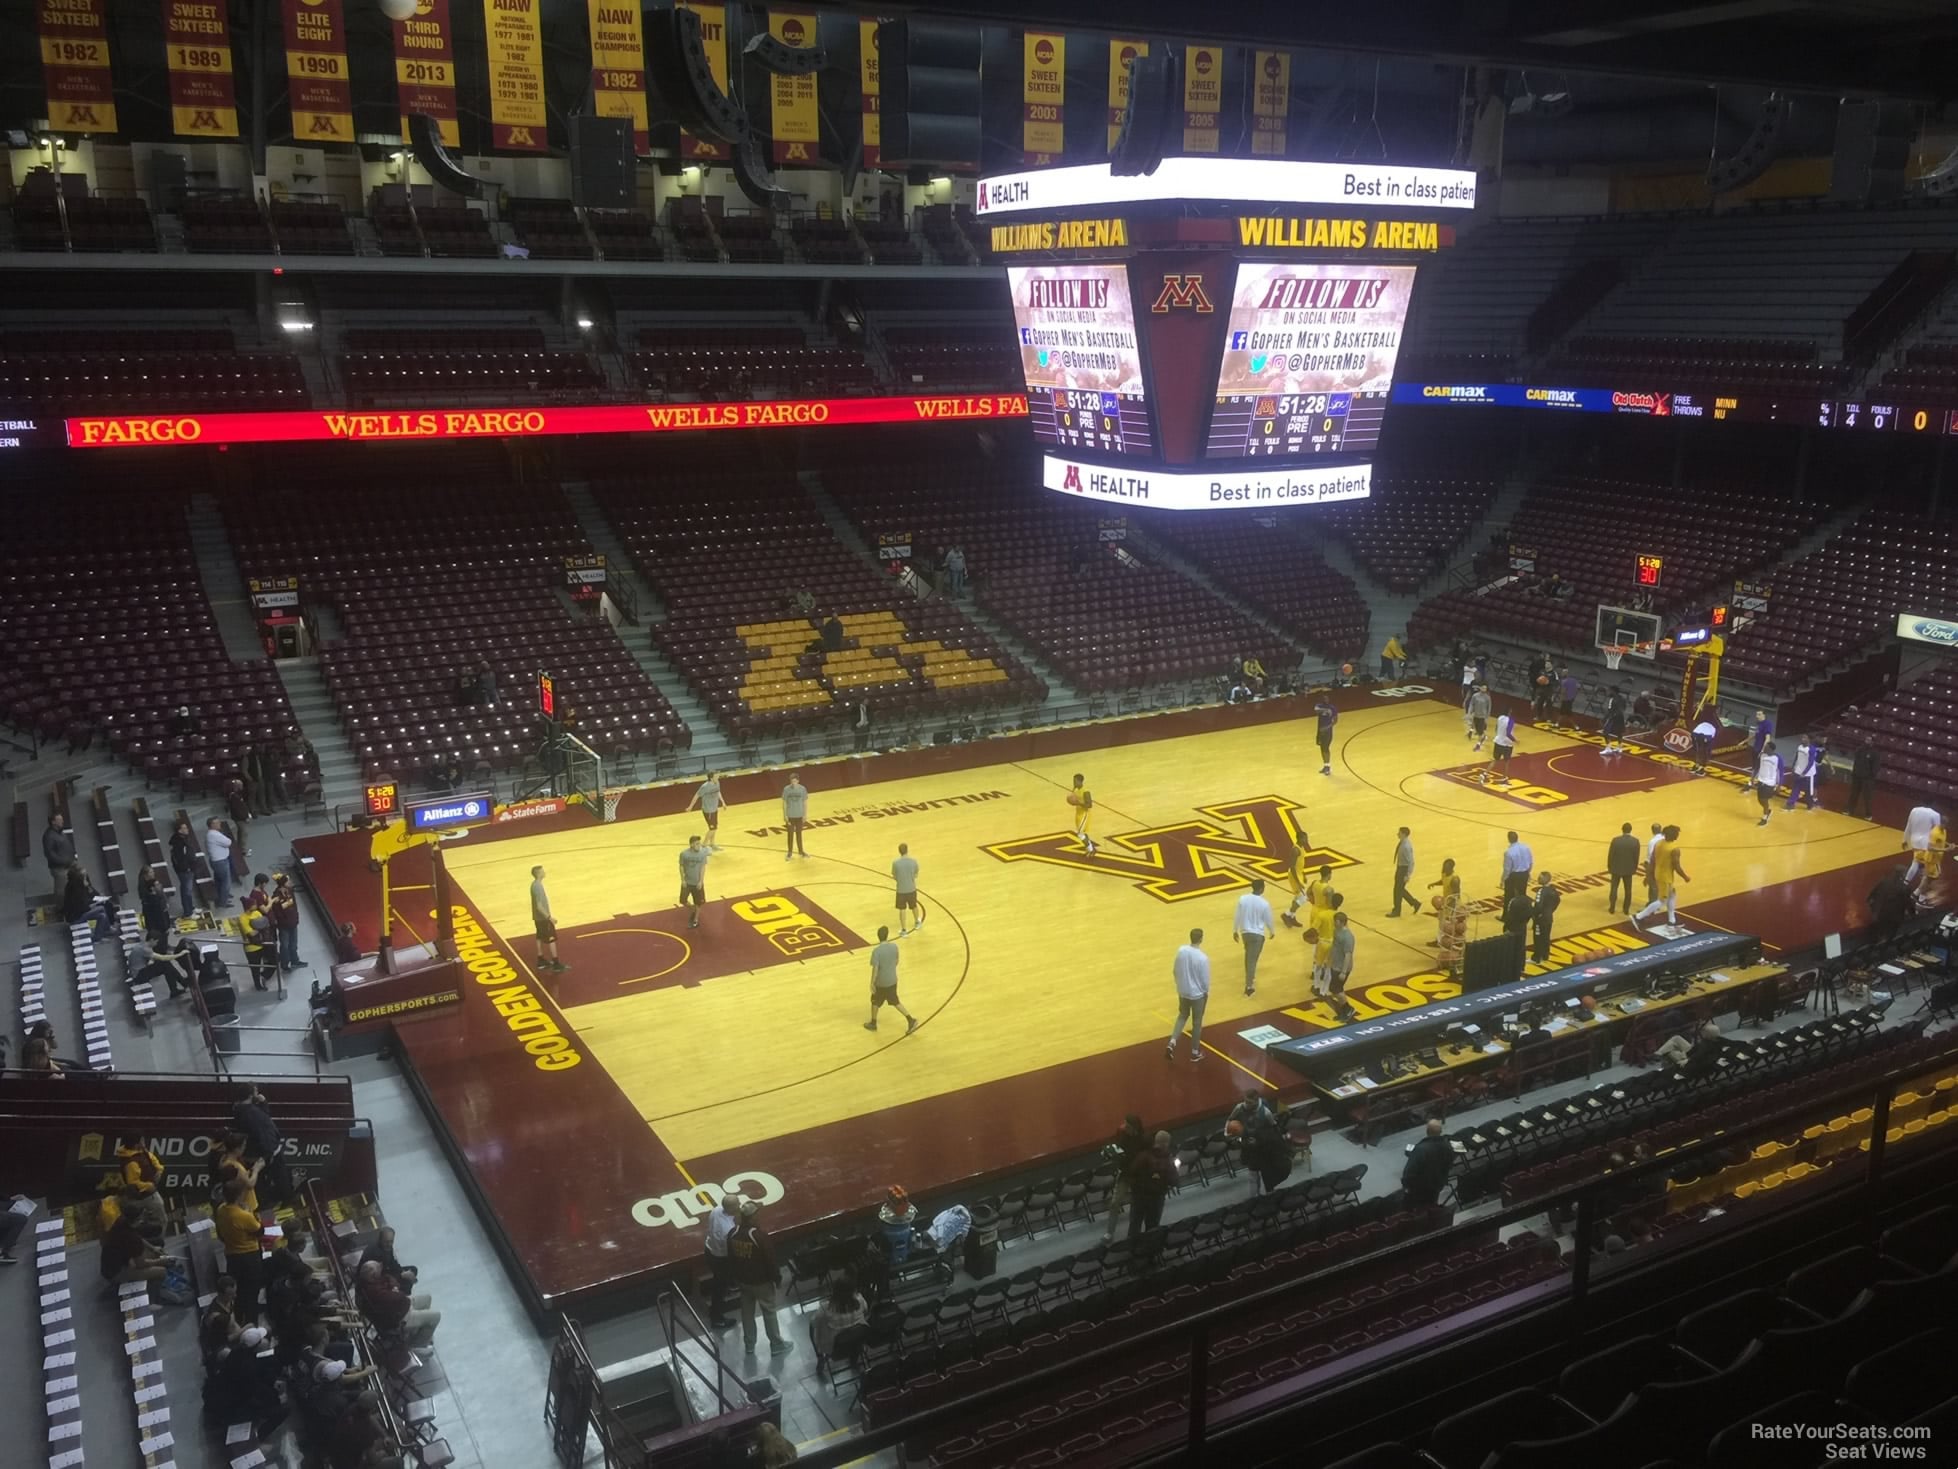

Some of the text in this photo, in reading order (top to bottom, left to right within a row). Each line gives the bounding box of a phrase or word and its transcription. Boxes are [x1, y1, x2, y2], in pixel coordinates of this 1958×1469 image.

[43, 11, 99, 26] SIXTEEN
[172, 4, 217, 19] SWEET
[296, 12, 330, 27] ELITE
[597, 9, 633, 25] AIAW
[169, 18, 223, 35] SIXTEEN
[296, 27, 332, 42] EIGHT
[405, 20, 440, 35] THIRD
[495, 30, 512, 39] 1977
[403, 35, 444, 50] ROUND
[597, 32, 636, 42] REGION VI
[51, 43, 99, 62] 1982
[594, 41, 641, 52] CHAMPIONS
[177, 49, 222, 68] 1989
[506, 52, 525, 61] 1982
[296, 56, 339, 75] 1990
[406, 64, 445, 81] 2013
[601, 71, 637, 89] 1982
[1031, 71, 1057, 81] SWEET
[1028, 82, 1060, 94] SIXTEEN
[1191, 80, 1216, 91] SWEET
[1188, 92, 1218, 102] SIXTEEN
[1030, 106, 1057, 119] 2003
[1190, 114, 1214, 127] 2005
[992, 181, 1029, 205] HEALTH
[1344, 174, 1381, 196] Best
[1387, 176, 1400, 196] in
[1405, 176, 1437, 198] class
[992, 218, 1127, 251] WILLIAMS ARENA
[1239, 217, 1438, 250] WILLIAMS ARENA
[1032, 279, 1106, 308] FOLLOW US
[1267, 279, 1382, 308] FOLLOW US
[1056, 311, 1076, 323] SOCIAL
[1077, 311, 1097, 323] MEDIA
[1283, 311, 1356, 324] ON SOCIAL MEDIA
[1086, 330, 1134, 349] BASKETBALL
[1251, 330, 1396, 350] GOPHER MEN'S BASKETBALL
[914, 397, 1029, 418] WELLS FA
[1068, 391, 1101, 412] 51:28
[1279, 395, 1326, 415] 51:28
[1629, 393, 1654, 408] Dutch
[1674, 395, 1691, 405] FREE
[1715, 398, 1737, 409] MINN
[647, 403, 829, 428] WELLS FARGO
[1674, 406, 1702, 416] THROWS
[1714, 409, 1726, 420] NU
[1871, 405, 1893, 415] FOULS
[324, 411, 546, 437] WELLS FARGO
[1064, 413, 1111, 430] 0 PRE 0
[1264, 418, 1332, 434] 0 PRE 0
[1846, 414, 1884, 429] 4 0
[1914, 410, 1927, 431] 0
[80, 418, 202, 443] FARGO
[1249, 447, 1256, 456] 4
[1267, 446, 1273, 455] 0
[1331, 442, 1338, 451] 4
[1090, 473, 1366, 501] HEALTH Best in class patient
[1639, 556, 1661, 569] 51:28
[1640, 566, 1657, 583] 30
[1921, 623, 1956, 641] Ford
[1669, 732, 1691, 750] DQ
[368, 785, 394, 799] 51:28
[374, 798, 391, 810] 30
[861, 789, 1012, 820] WILLIAMS
[423, 806, 464, 822] Allianz
[1280, 929, 1650, 1030] MINNSOTA
[1513, 979, 1559, 995] FROM
[1476, 991, 1509, 1004] NYC
[349, 991, 460, 1022] GOPHERSPORTS.com
[487, 984, 582, 1071] GOLDEN
[1355, 1024, 1384, 1036] ON
[114, 1136, 185, 1156] LND
[305, 1143, 333, 1156] INC.
[632, 1171, 785, 1229] Cub
